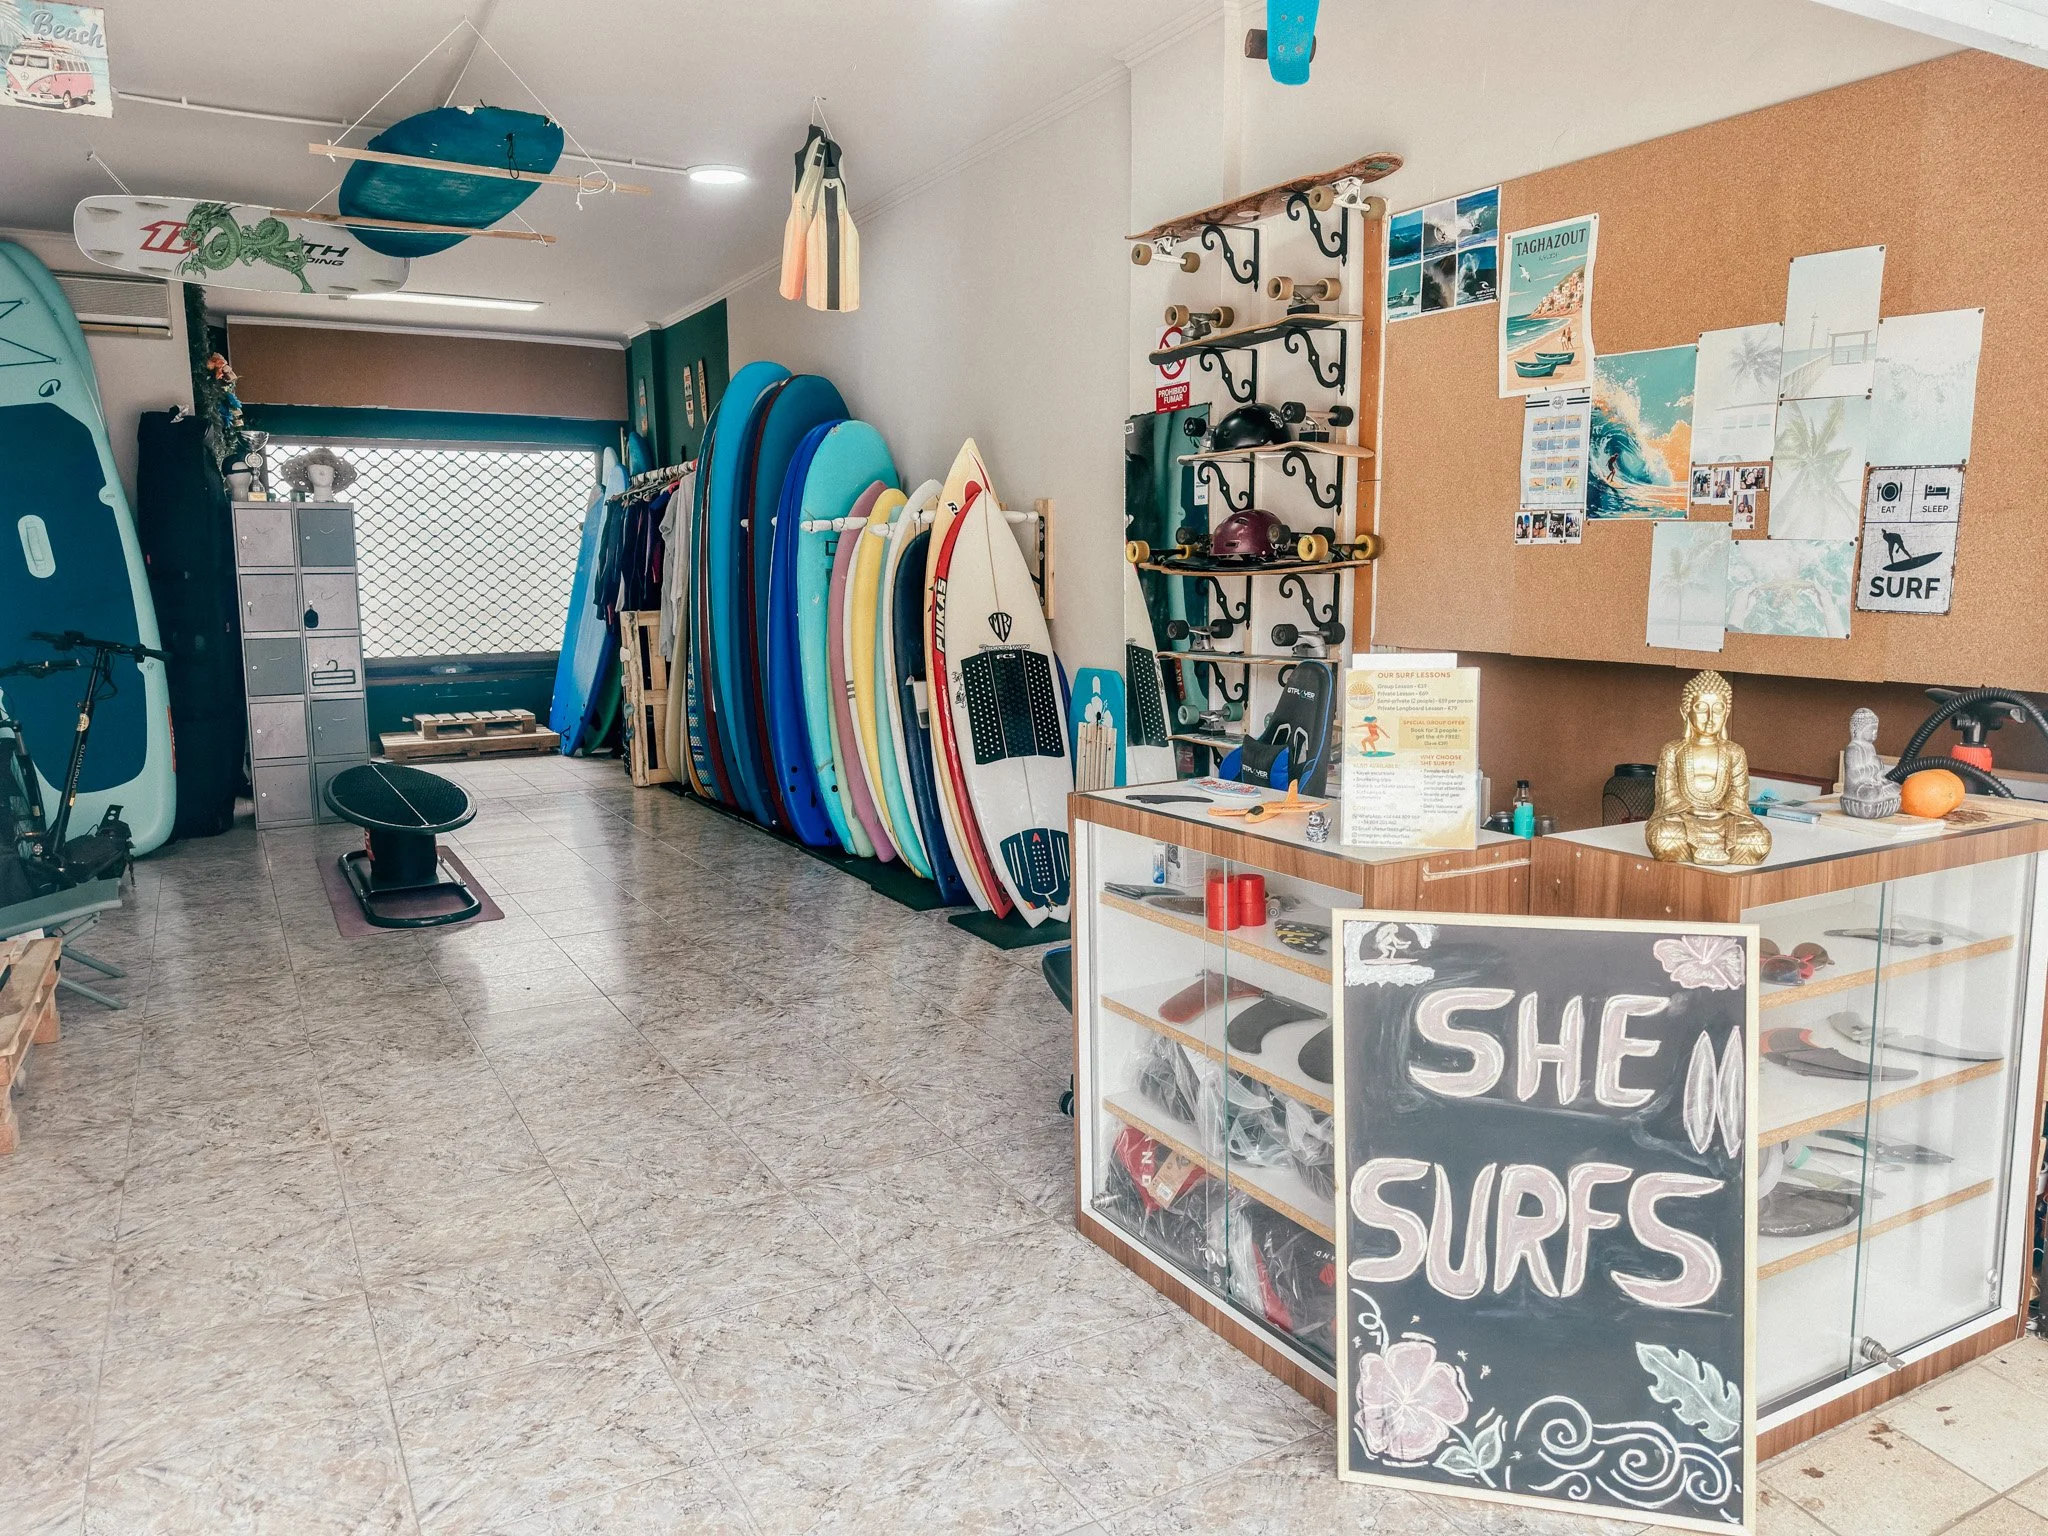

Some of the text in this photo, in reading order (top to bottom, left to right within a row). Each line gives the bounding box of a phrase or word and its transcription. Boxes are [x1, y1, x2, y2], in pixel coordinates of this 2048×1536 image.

[30, 9, 104, 48] Beach
[1516, 228, 1586, 256] TAGHAZOUT
[1158, 386, 1187, 398] PROHIBIDO
[1164, 393, 1183, 404] FUMAR
[1869, 576, 1940, 599] SURF
[936, 576, 948, 654] PUKAS
[1409, 987, 1670, 1109] SHE
[1347, 1157, 1725, 1309] SURFS
